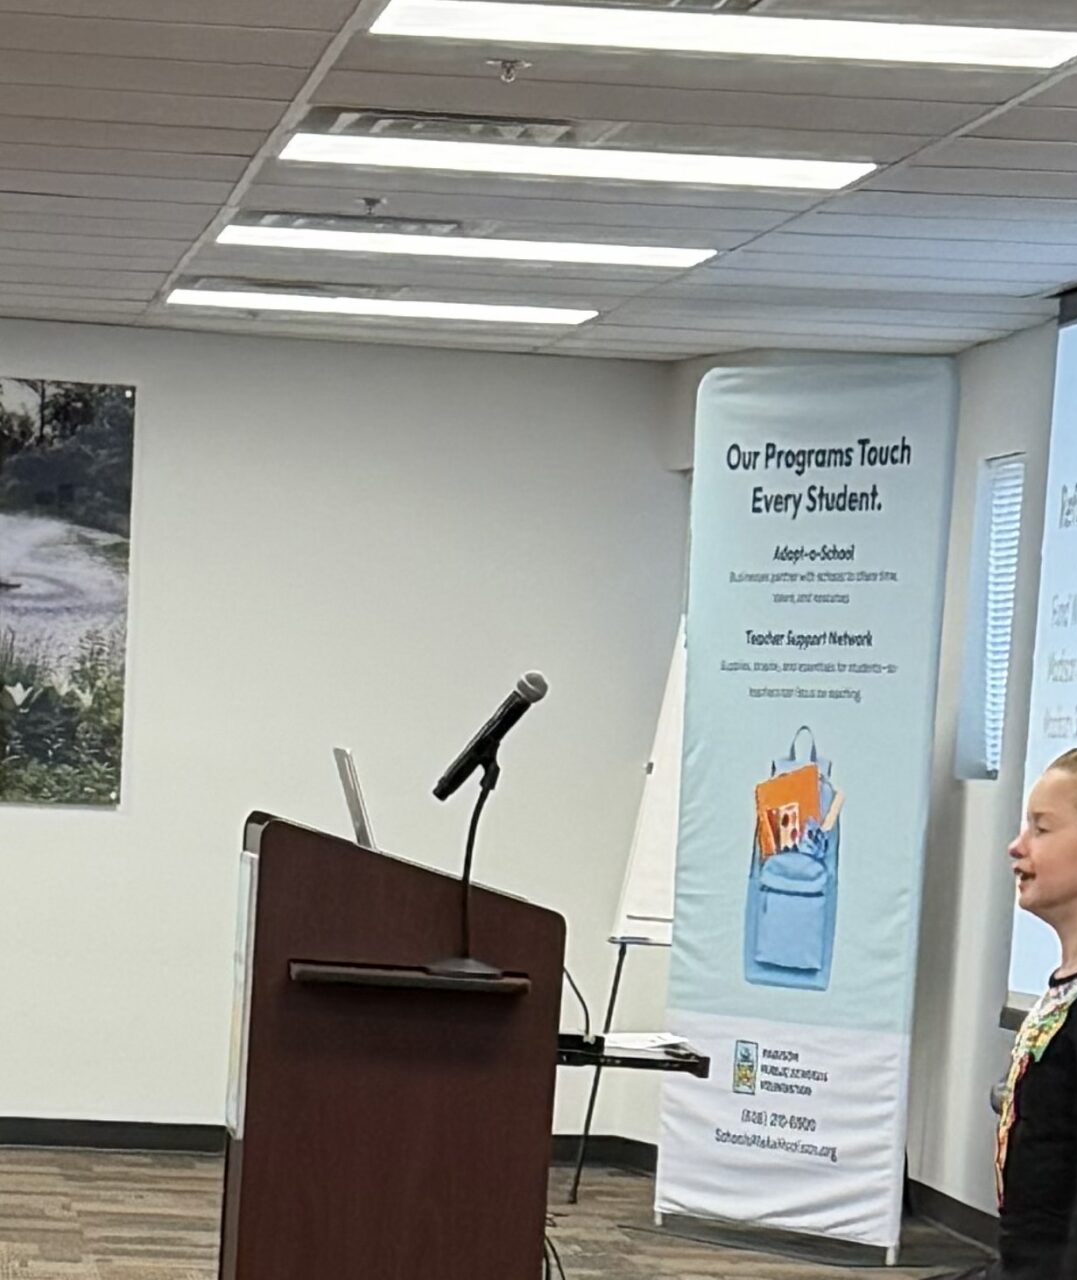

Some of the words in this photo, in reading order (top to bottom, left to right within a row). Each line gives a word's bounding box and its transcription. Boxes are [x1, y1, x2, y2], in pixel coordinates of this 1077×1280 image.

[727, 443, 761, 470] Our
[764, 442, 854, 476] Programs
[857, 436, 911, 467] Touch
[751, 486, 802, 519] Every
[805, 484, 883, 513] Student.
[745, 629, 785, 646] Teacher
[787, 629, 827, 650] Support
[828, 630, 873, 647] Network
